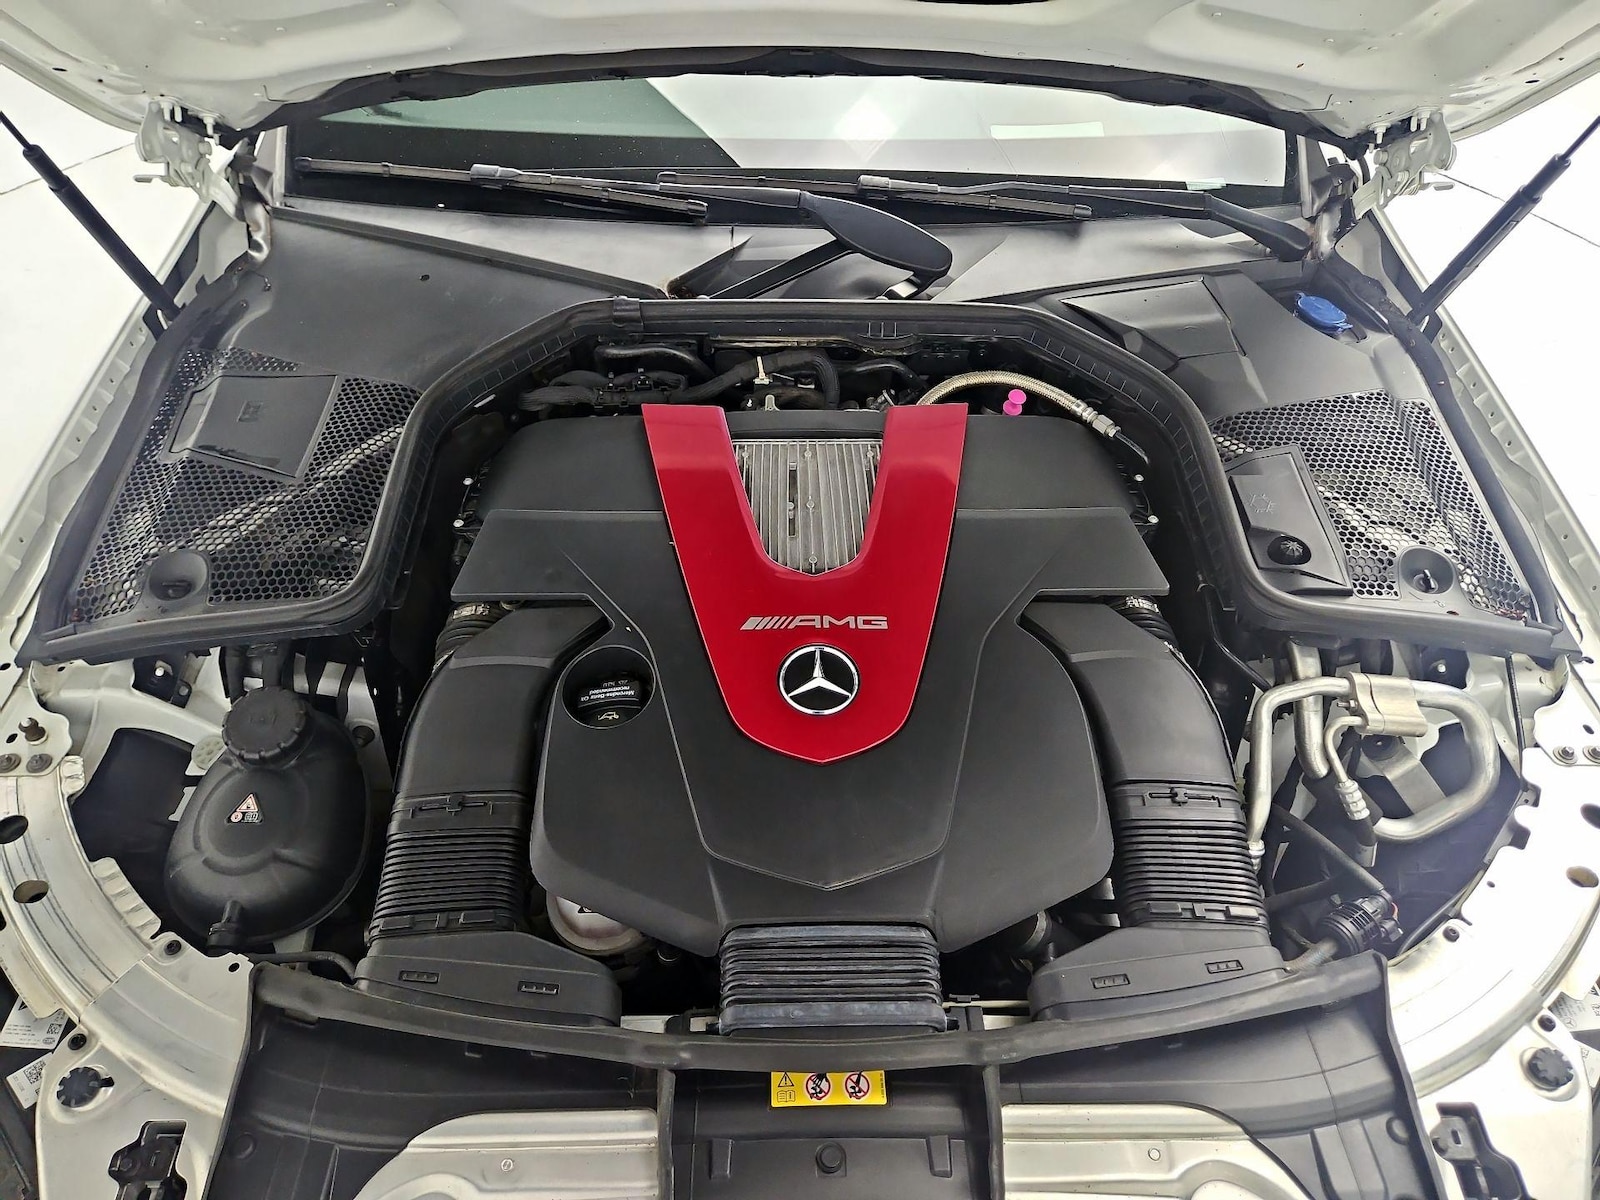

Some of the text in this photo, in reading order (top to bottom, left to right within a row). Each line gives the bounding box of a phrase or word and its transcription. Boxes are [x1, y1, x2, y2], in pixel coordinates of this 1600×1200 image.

[787, 615, 888, 629] AMG
[589, 685, 630, 695] recommended
[590, 690, 635, 699] Mercedes-Benz
